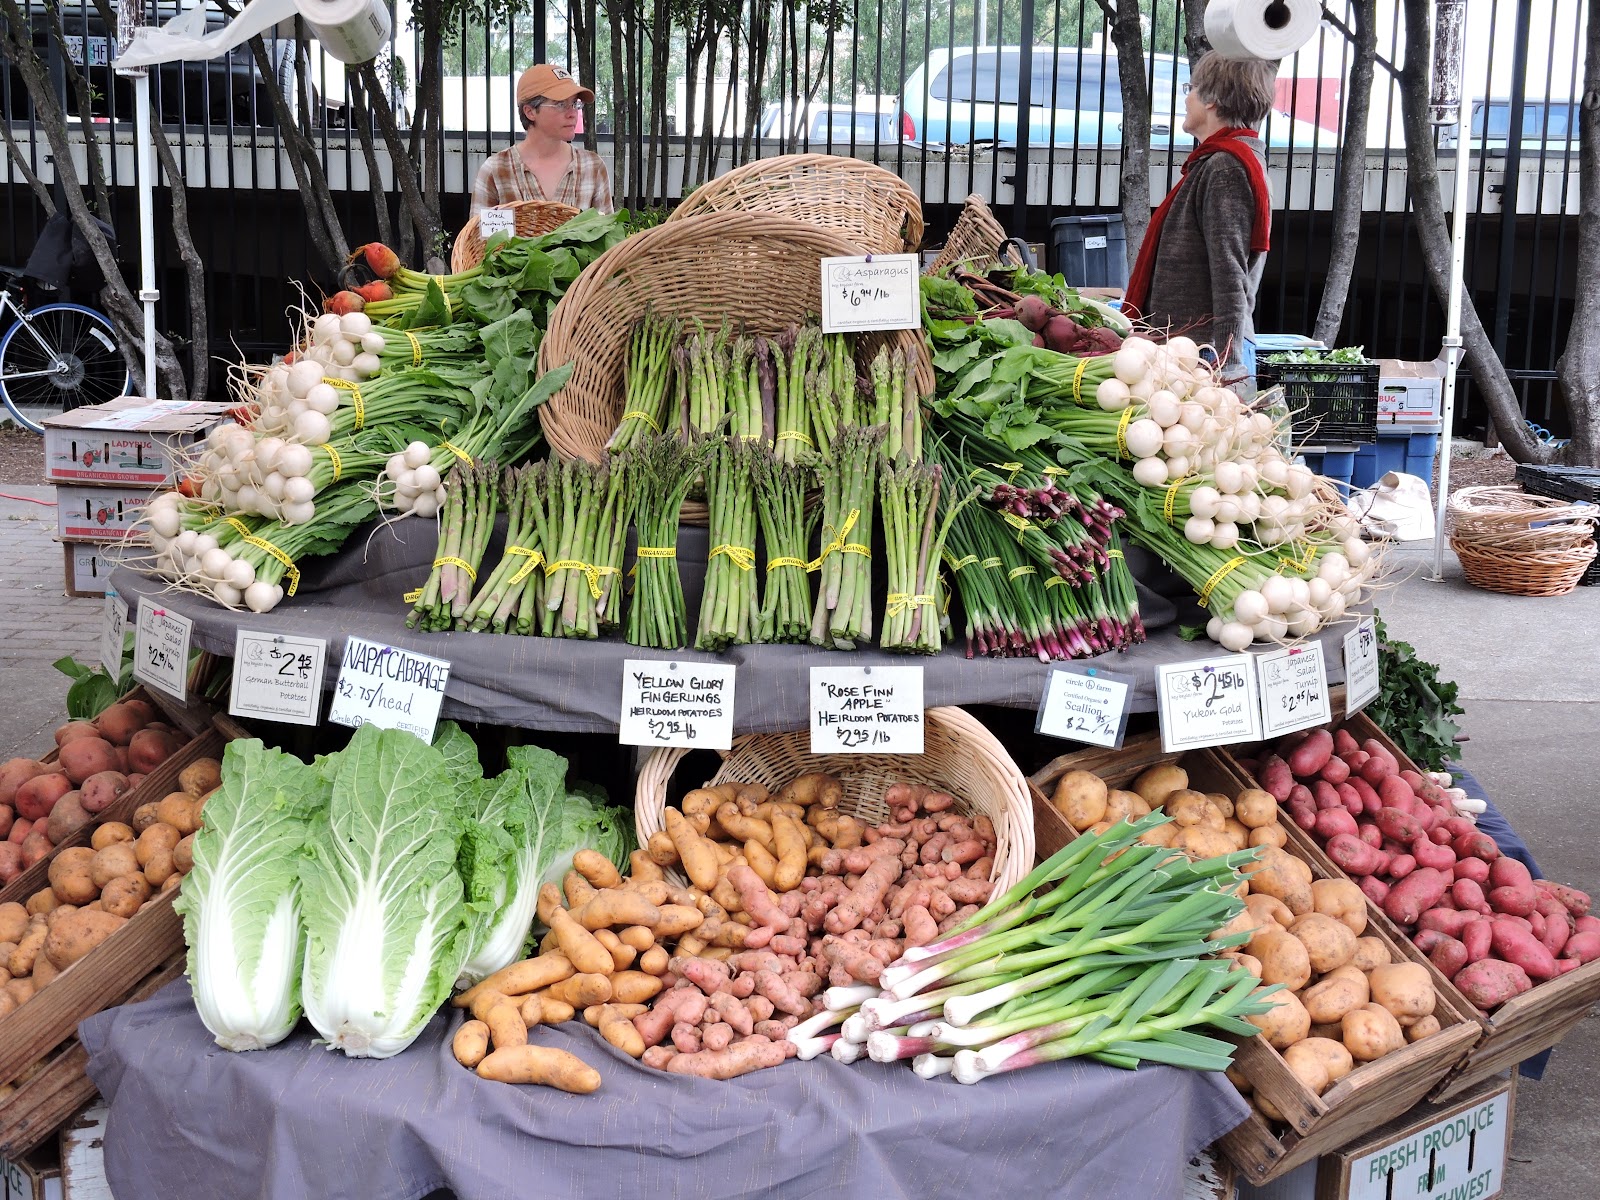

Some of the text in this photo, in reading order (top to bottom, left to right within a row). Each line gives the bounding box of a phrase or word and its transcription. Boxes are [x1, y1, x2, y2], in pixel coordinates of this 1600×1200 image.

[854, 268, 909, 279] Asparagus
[112, 440, 152, 449] LADYBUG
[1166, 490, 1174, 513] GROWN
[269, 546, 288, 561] GROWN
[460, 562, 476, 578] GROWN
[521, 559, 537, 575] GROWN
[158, 617, 183, 636] Japanese
[164, 633, 181, 646] Salad
[162, 642, 181, 662] Turnip
[343, 640, 449, 693] NAPA CABBAGE
[1286, 653, 1316, 671] Japanese
[1296, 664, 1316, 677] Salad
[246, 676, 309, 689] German Butterball
[633, 672, 724, 690] YELLOW GLORY
[1066, 678, 1084, 687] circle
[1096, 684, 1112, 692] farm
[1295, 676, 1318, 690] Turnip
[280, 692, 307, 702] Potatoes
[338, 677, 414, 715] $2.75/head
[641, 691, 721, 704] FINGERLINGS
[863, 685, 894, 698] FINN
[1064, 692, 1102, 704] Certified Organic
[630, 707, 722, 718] HEIRLOOM POTATOES
[1065, 701, 1102, 716] Scallion
[1183, 704, 1242, 723] Yukon Gold
[330, 709, 351, 724] Circle
[818, 711, 919, 726] HEIRLOOM POTATOES
[396, 721, 430, 736] CERTIFIED
[1369, 1102, 1494, 1183] FRESH PRODUCE
